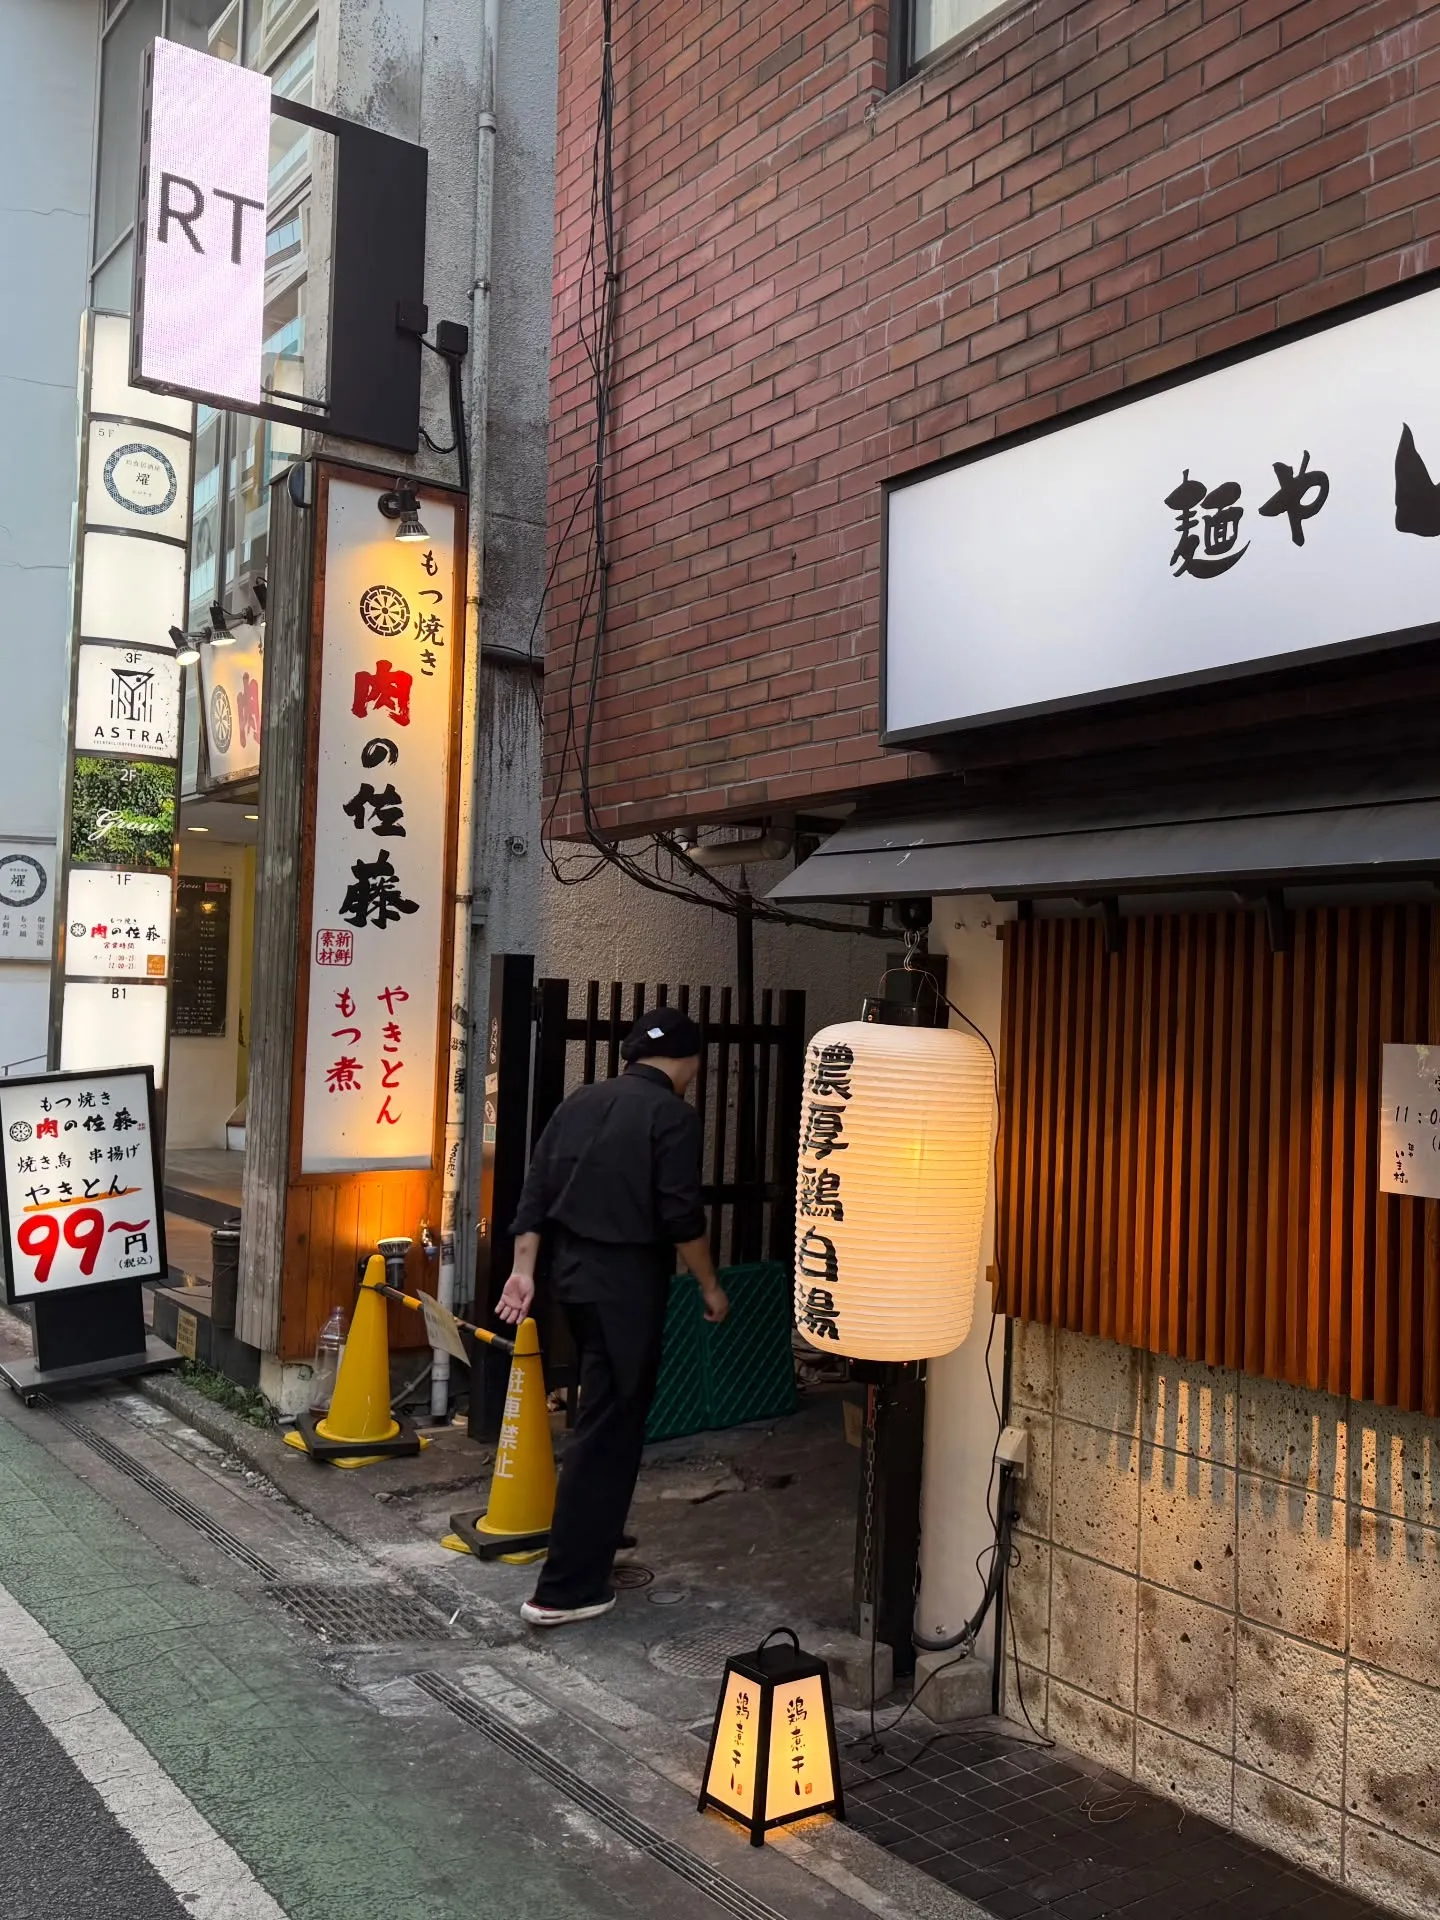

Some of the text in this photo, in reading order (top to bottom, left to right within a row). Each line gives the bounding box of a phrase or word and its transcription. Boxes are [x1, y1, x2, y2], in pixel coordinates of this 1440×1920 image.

[157, 171, 264, 265] RT
[98, 428, 114, 438] 5F
[1164, 450, 1330, 579] 麺や
[414, 550, 445, 676] もつ焼き
[125, 652, 142, 664] 3F
[94, 726, 164, 744] ASTRA
[120, 769, 137, 781] 2F
[338, 659, 420, 930] 肉の佐藤
[117, 874, 132, 885] 1F
[90, 923, 160, 941] 肉の佐藤
[111, 988, 126, 1000] B1
[325, 987, 364, 1093] もつ煮
[376, 985, 409, 1124] やきとん
[41, 1091, 112, 1112] もつ焼き
[1395, 1105, 1440, 1125] 11:0
[36, 1107, 138, 1139] 肉の佐藤
[17, 1142, 141, 1174] 焼き鳥 串揚げ
[25, 1175, 128, 1206] やきとん
[786, 1696, 808, 1796] 鶏煮干し
